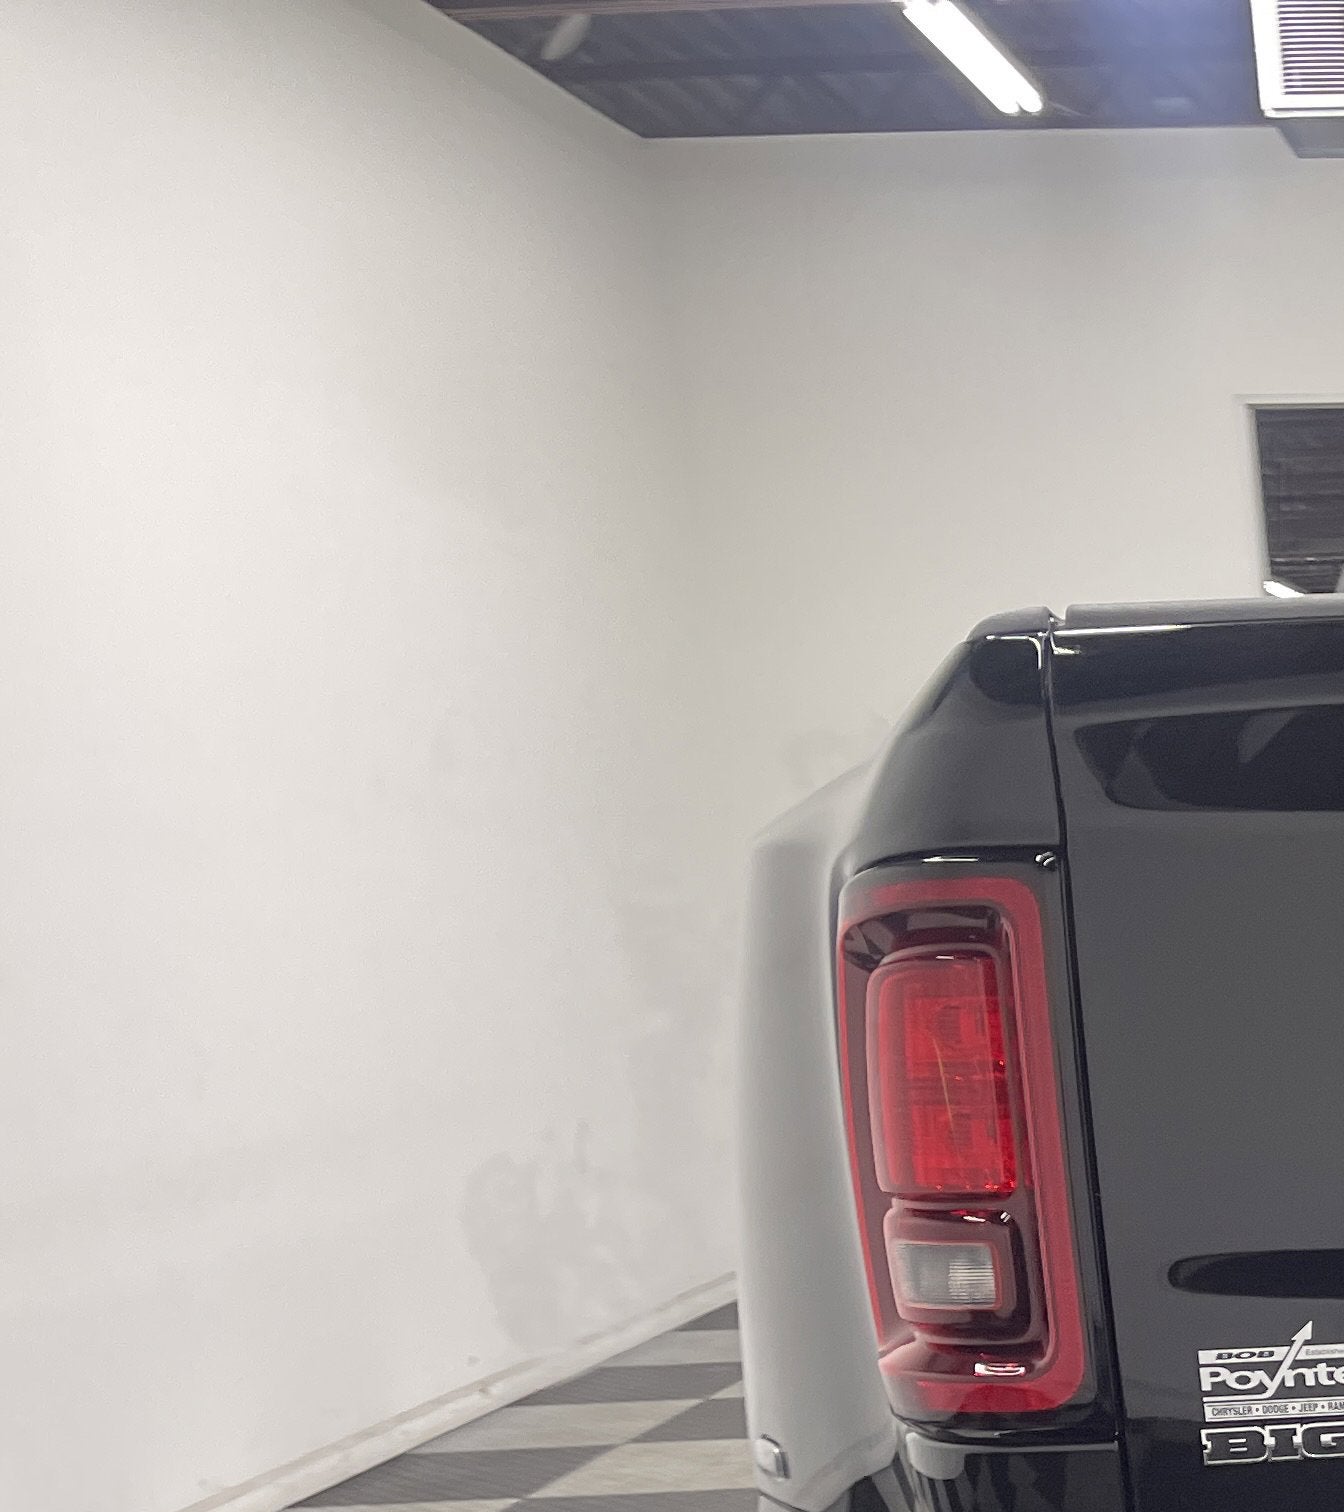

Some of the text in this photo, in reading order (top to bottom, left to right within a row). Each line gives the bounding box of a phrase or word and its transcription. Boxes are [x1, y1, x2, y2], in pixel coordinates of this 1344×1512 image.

[1215, 1350, 1275, 1361] BOB
[1211, 1406, 1253, 1417] CHRYSLER
[1262, 1404, 1289, 1415] DODGE
[1299, 1403, 1319, 1413] JEEP
